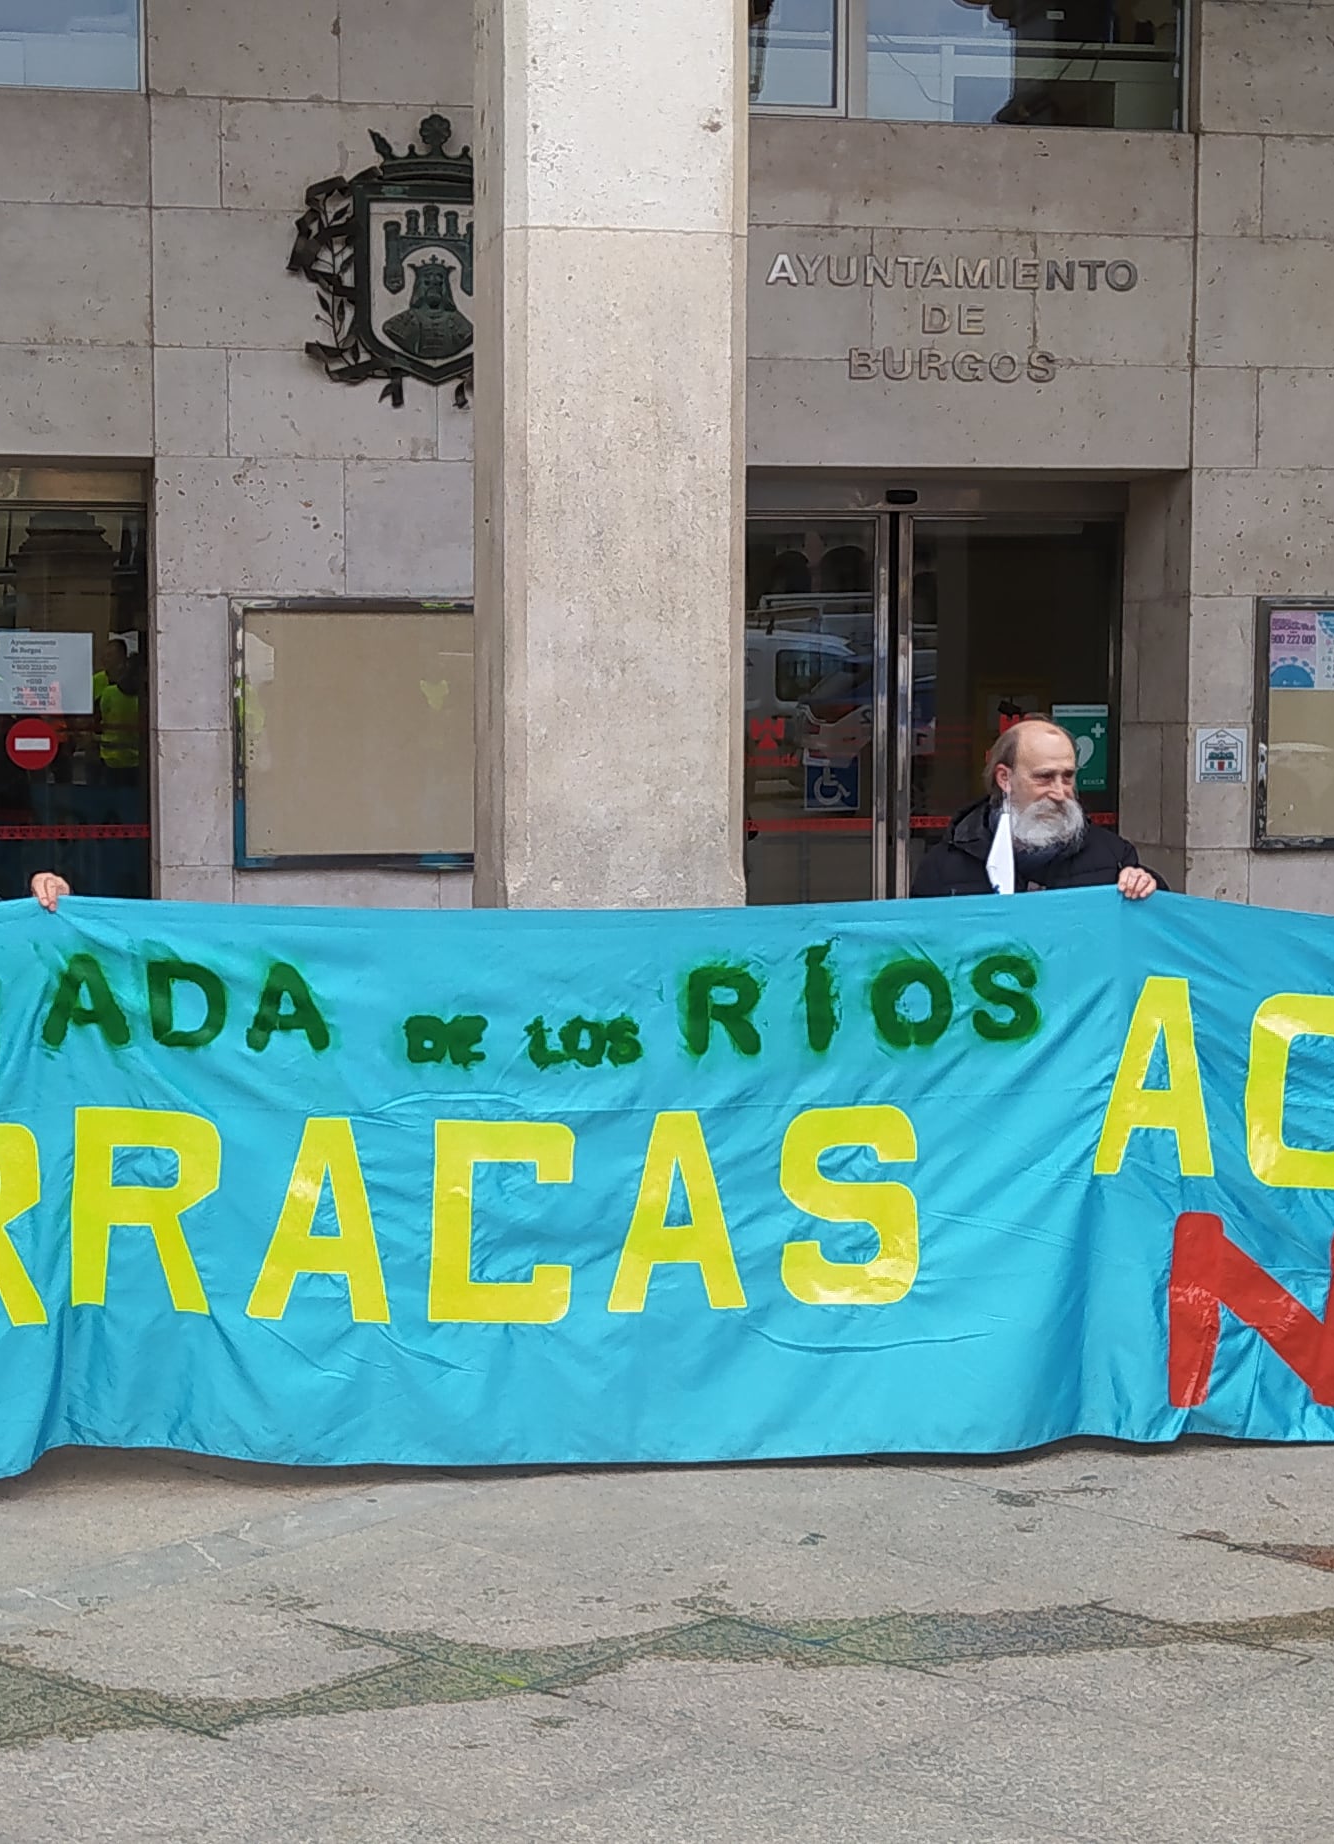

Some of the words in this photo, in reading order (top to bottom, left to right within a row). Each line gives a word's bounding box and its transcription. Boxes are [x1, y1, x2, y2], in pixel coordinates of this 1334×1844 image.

[767, 253, 1138, 292] AYUNTAMIENTO
[921, 302, 985, 335] DE
[848, 347, 1057, 383] BURGOS
[403, 1014, 489, 1069] DE
[525, 1014, 645, 1070] LOS
